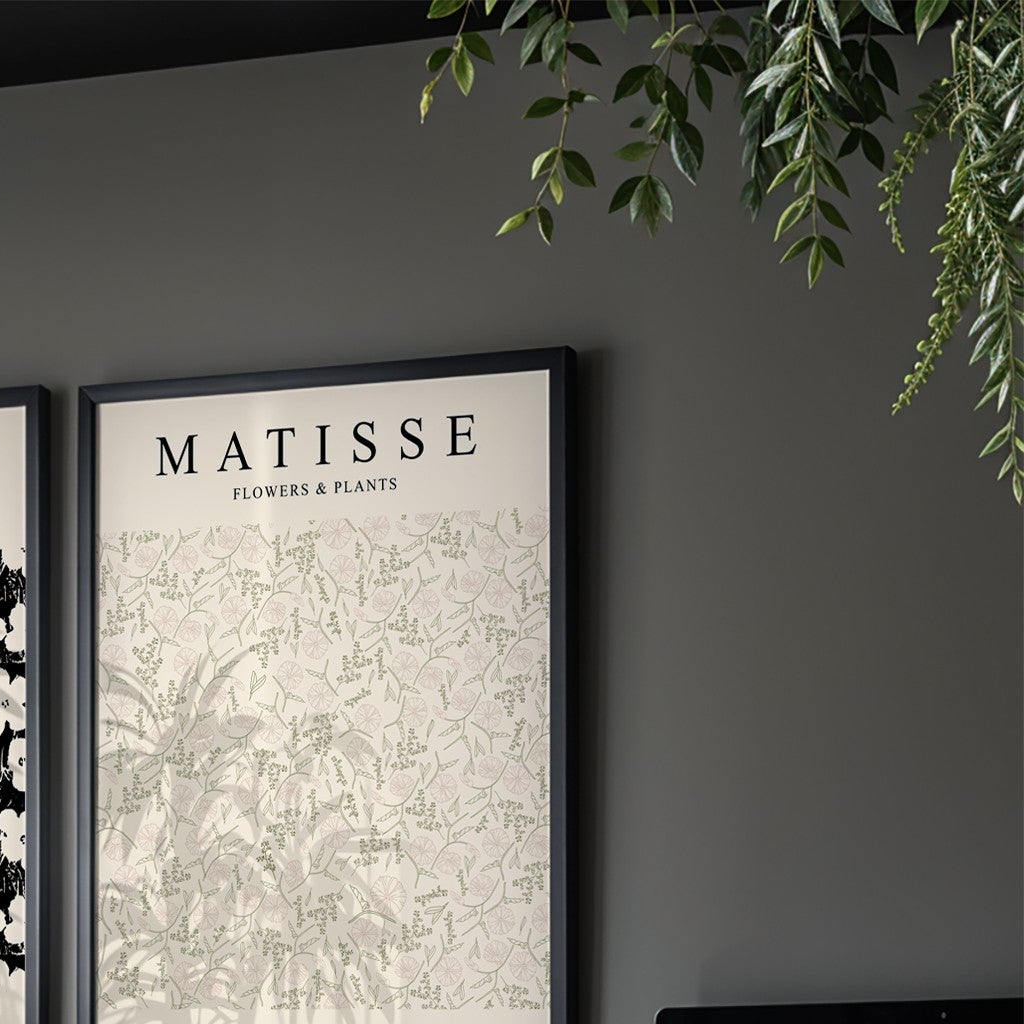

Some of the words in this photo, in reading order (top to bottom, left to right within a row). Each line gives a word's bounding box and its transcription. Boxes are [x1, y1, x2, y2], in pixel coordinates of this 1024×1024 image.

[156, 414, 477, 476] MATISSE
[233, 483, 309, 500] FLOWERS
[316, 482, 327, 495] &
[334, 477, 397, 494] PLANTS
